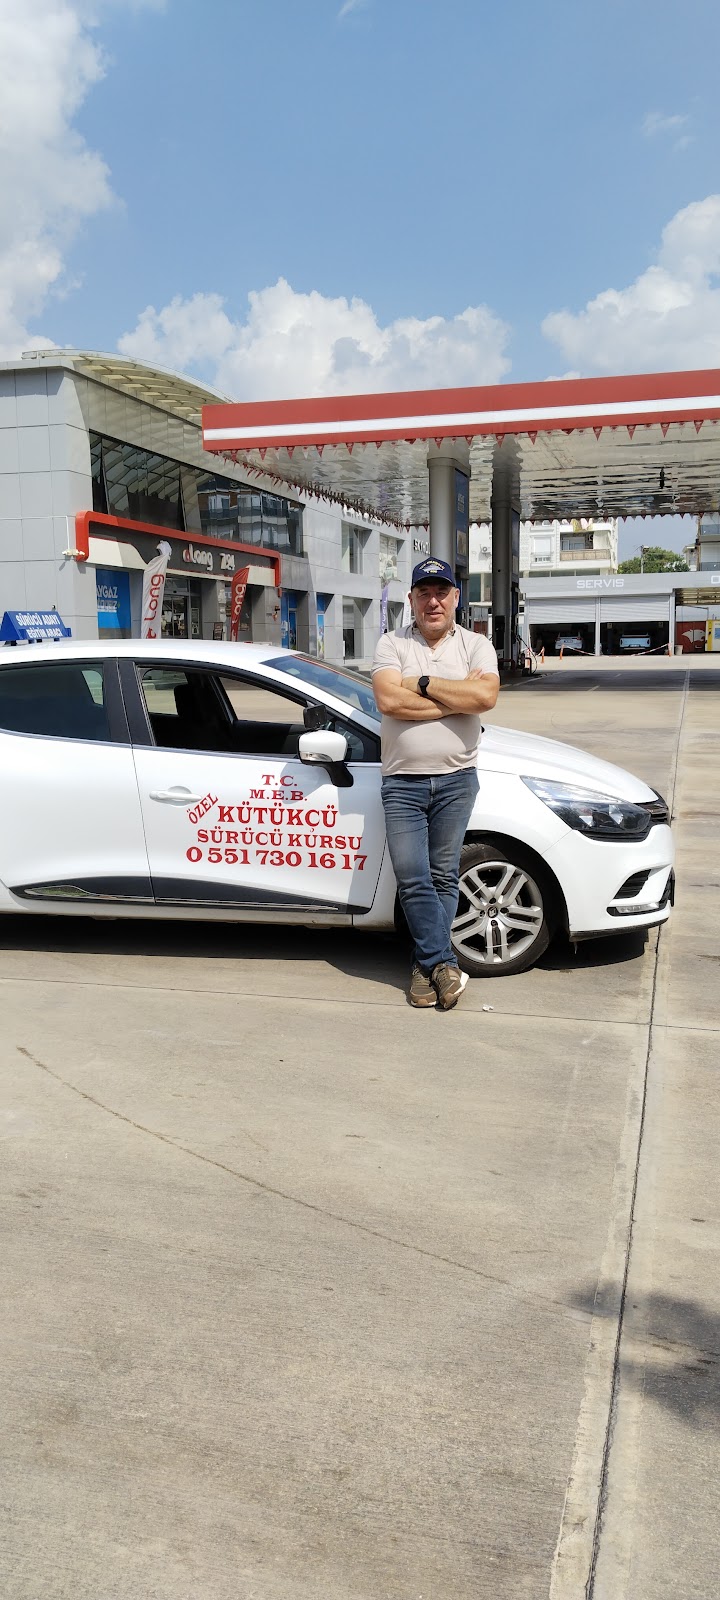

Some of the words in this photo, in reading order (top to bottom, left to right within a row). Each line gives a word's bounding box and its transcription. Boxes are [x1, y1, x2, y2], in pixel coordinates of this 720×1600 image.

[576, 578, 625, 589] SERVIS
[15, 612, 43, 626] SÜRÜCÜ
[261, 774, 299, 787] T.C.
[249, 788, 308, 802] M.E.B.
[186, 792, 219, 825] ÖZEL
[217, 801, 338, 829] KÜTÜKÇÜ
[197, 826, 283, 847] SÜRÜCÜ
[288, 833, 362, 851] KURSU
[207, 847, 251, 866] 551
[255, 849, 302, 868] 730
[308, 851, 336, 870] 16
[341, 853, 368, 871] 17
